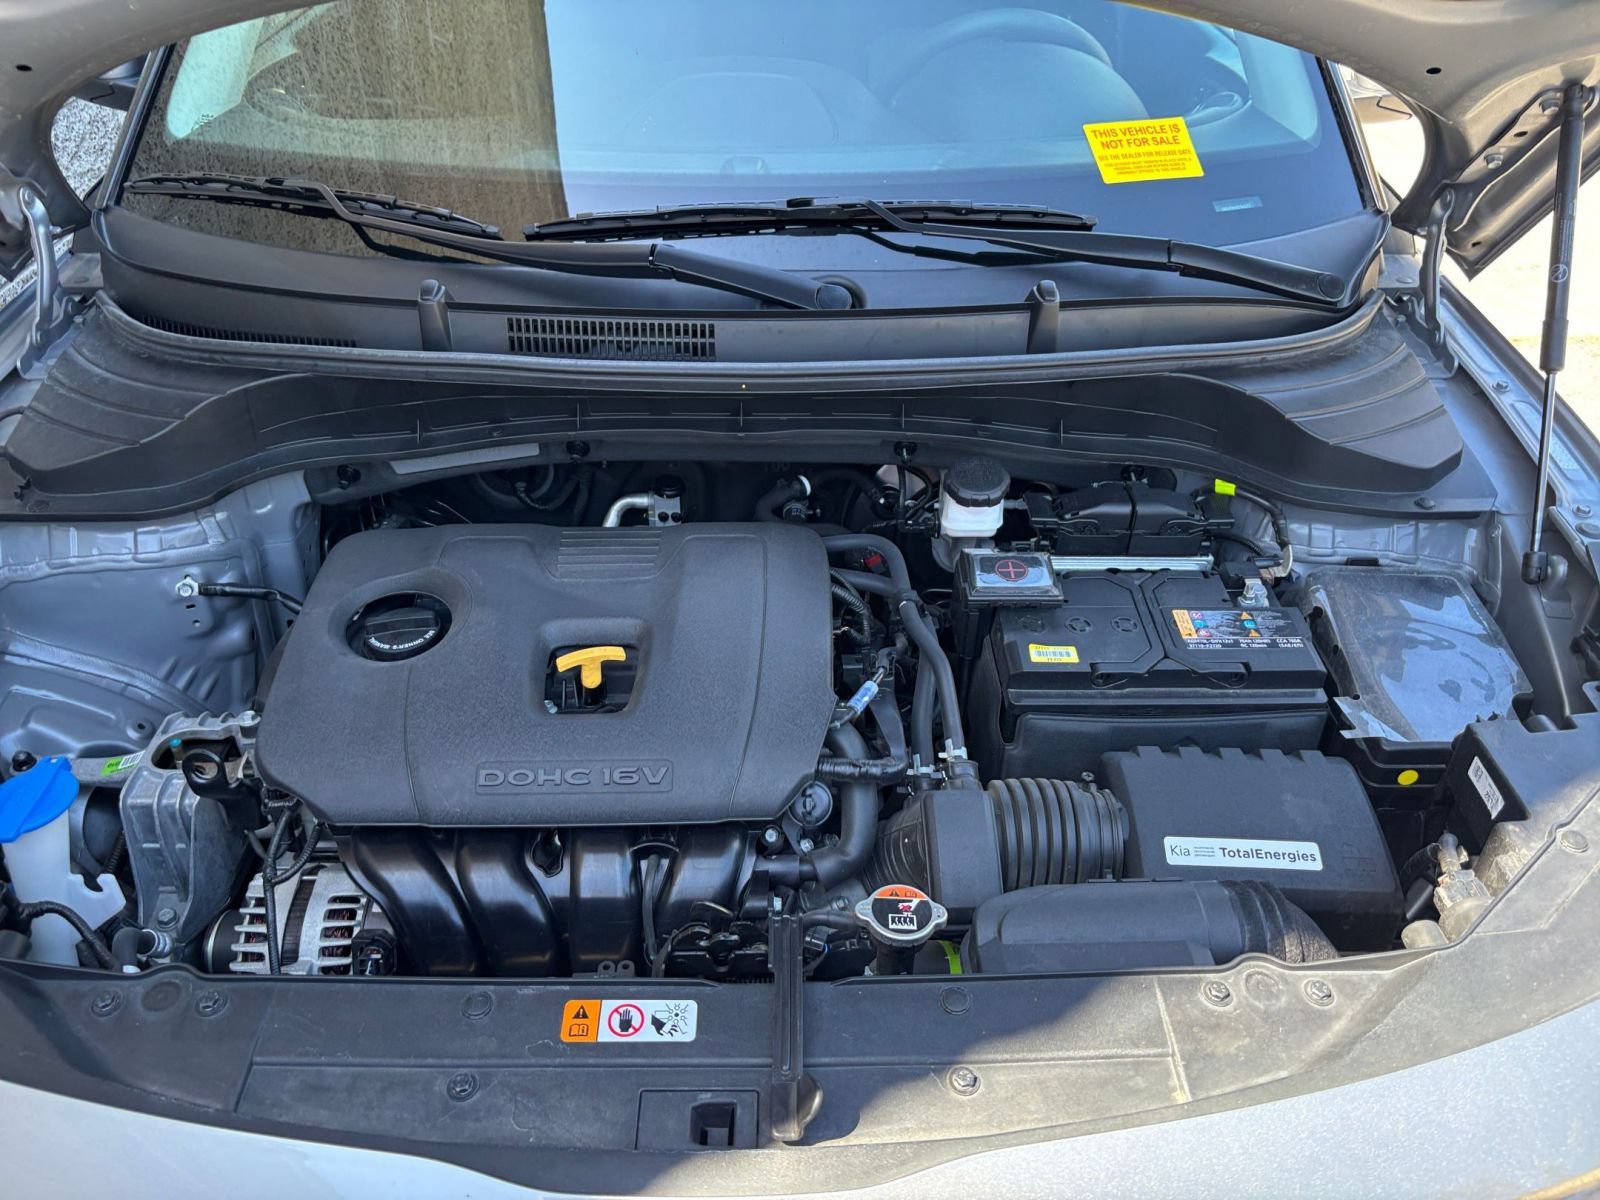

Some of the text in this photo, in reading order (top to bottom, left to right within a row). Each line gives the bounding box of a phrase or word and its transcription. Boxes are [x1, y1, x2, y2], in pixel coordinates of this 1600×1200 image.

[1091, 123, 1180, 139] THIS VEHICLE IS
[1101, 135, 1181, 150] NOT FOR SALE
[1121, 152, 1142, 160] DEALER
[478, 766, 669, 787] DOHC 16V
[1170, 845, 1191, 857] Kia
[1219, 847, 1317, 863] TotalEnergies
